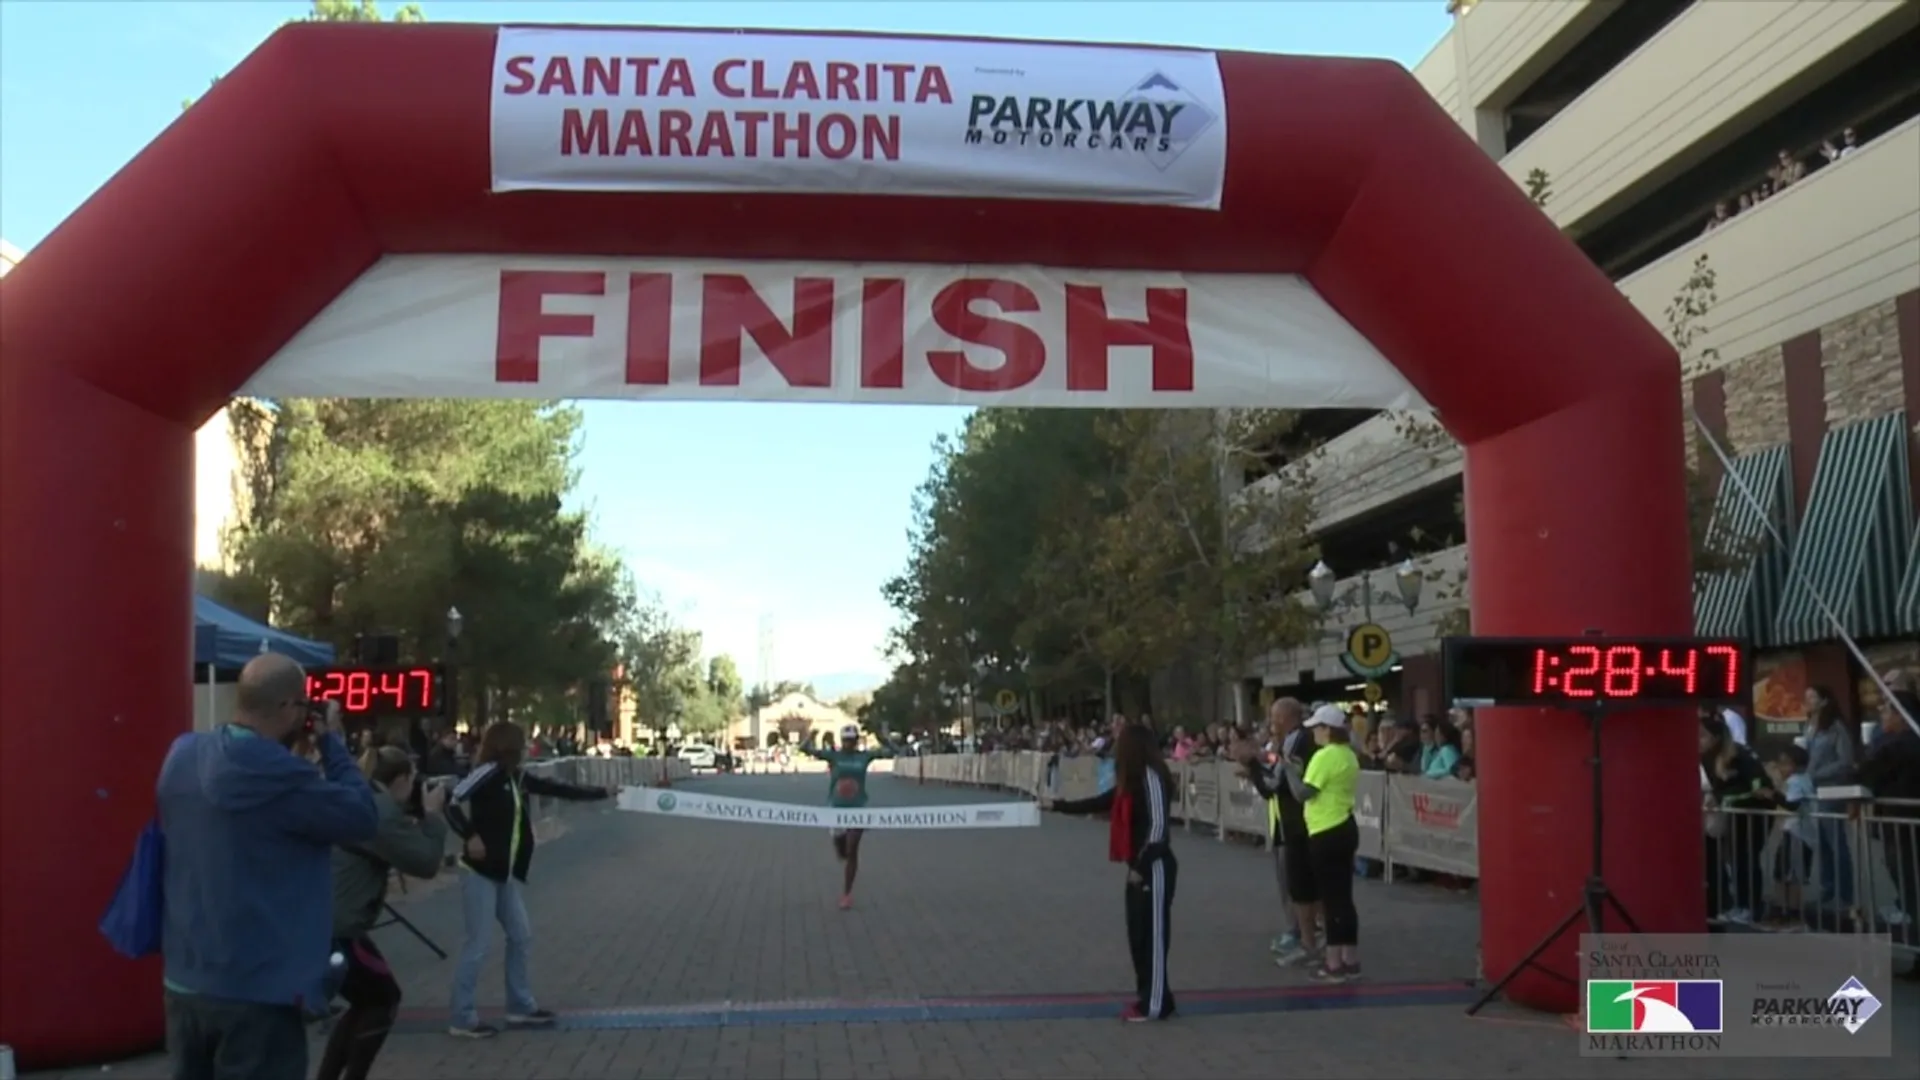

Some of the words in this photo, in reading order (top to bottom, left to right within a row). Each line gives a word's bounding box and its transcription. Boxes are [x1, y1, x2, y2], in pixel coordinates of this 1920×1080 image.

[504, 56, 696, 98] SANTA
[712, 60, 953, 104] CLARITA
[560, 110, 901, 161] MARATHON
[968, 94, 1184, 136] PARKWAY
[965, 128, 1172, 152] MOTORCARS
[494, 270, 1195, 392] FINISH
[1362, 634, 1382, 658] P
[705, 800, 753, 819] SANTA
[757, 806, 819, 824] CLARITA
[836, 812, 875, 825] HALF
[879, 809, 967, 826] MARATHON
